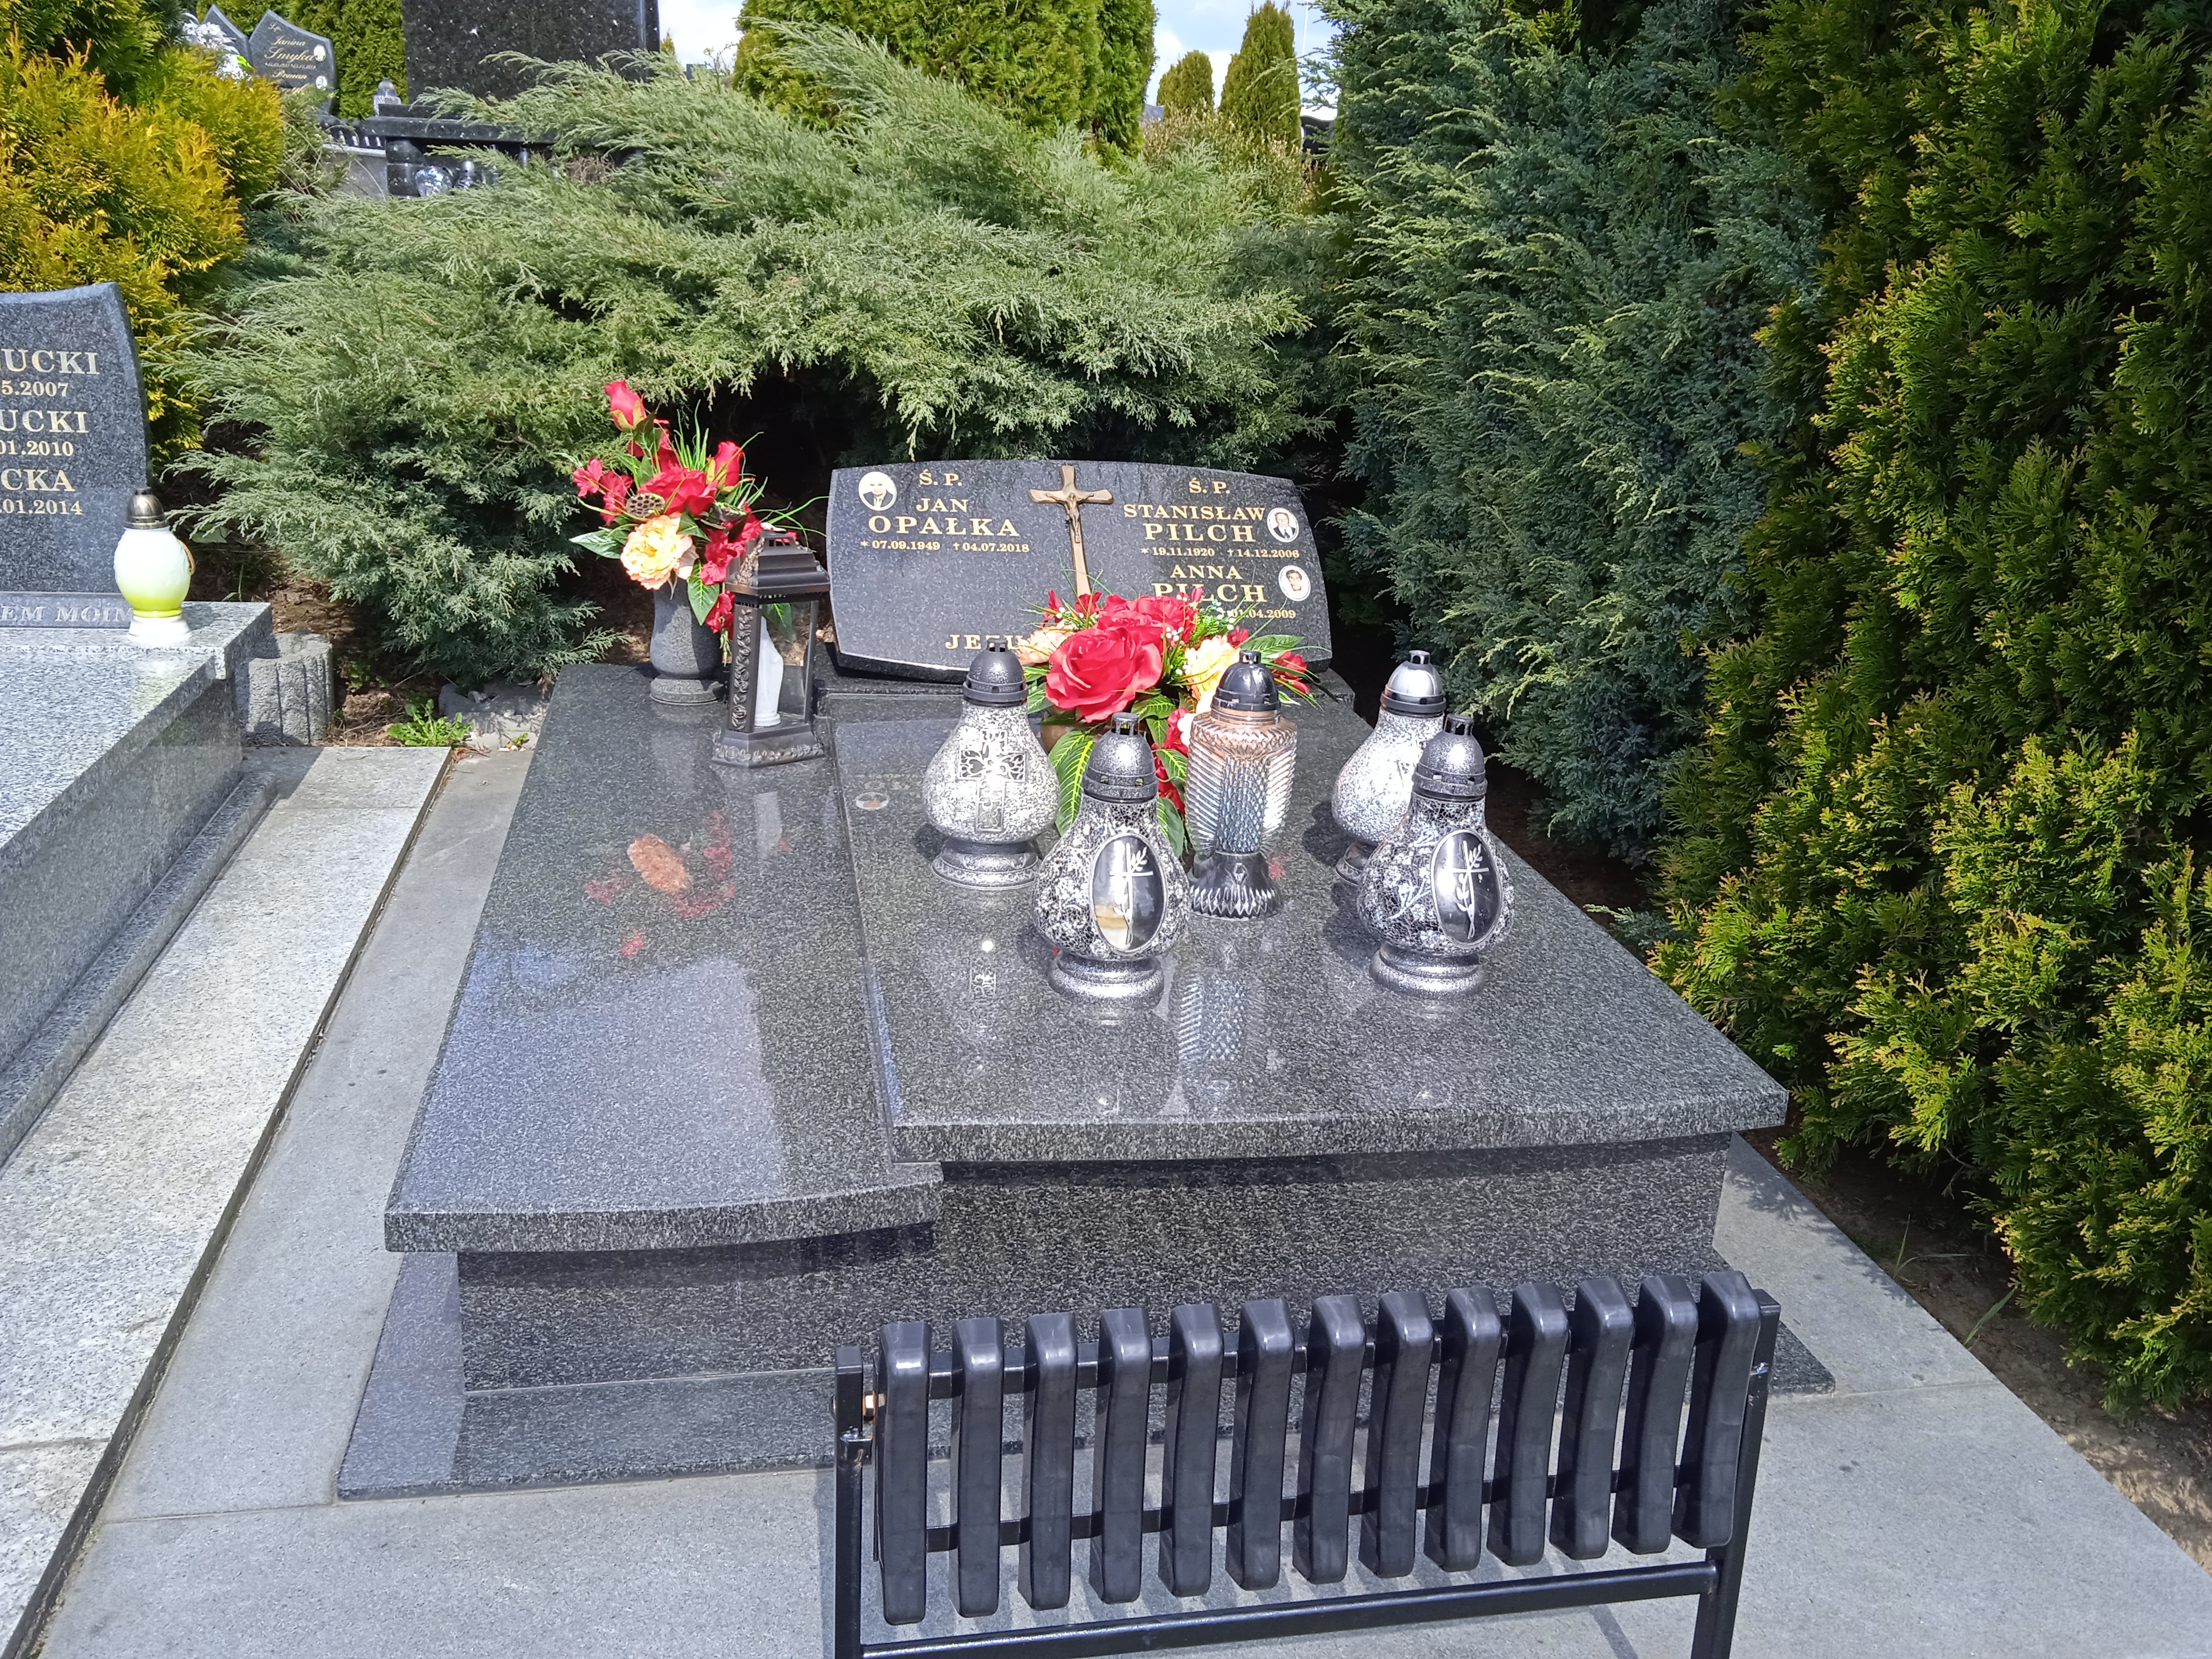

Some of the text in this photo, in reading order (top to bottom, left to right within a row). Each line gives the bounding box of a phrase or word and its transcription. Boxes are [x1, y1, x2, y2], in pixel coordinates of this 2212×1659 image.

[0, 348, 100, 374] UCKI
[1, 468, 75, 491] CKA
[916, 498, 968, 513] JAN
[1124, 504, 1266, 521] STANISŁAW
[868, 515, 1020, 537] OPAŁKA
[1143, 523, 1256, 542] PILCH
[872, 540, 940, 550] 07.09.1949
[1152, 547, 1215, 557] 19.11.1920
[1170, 565, 1243, 580] ANNA
